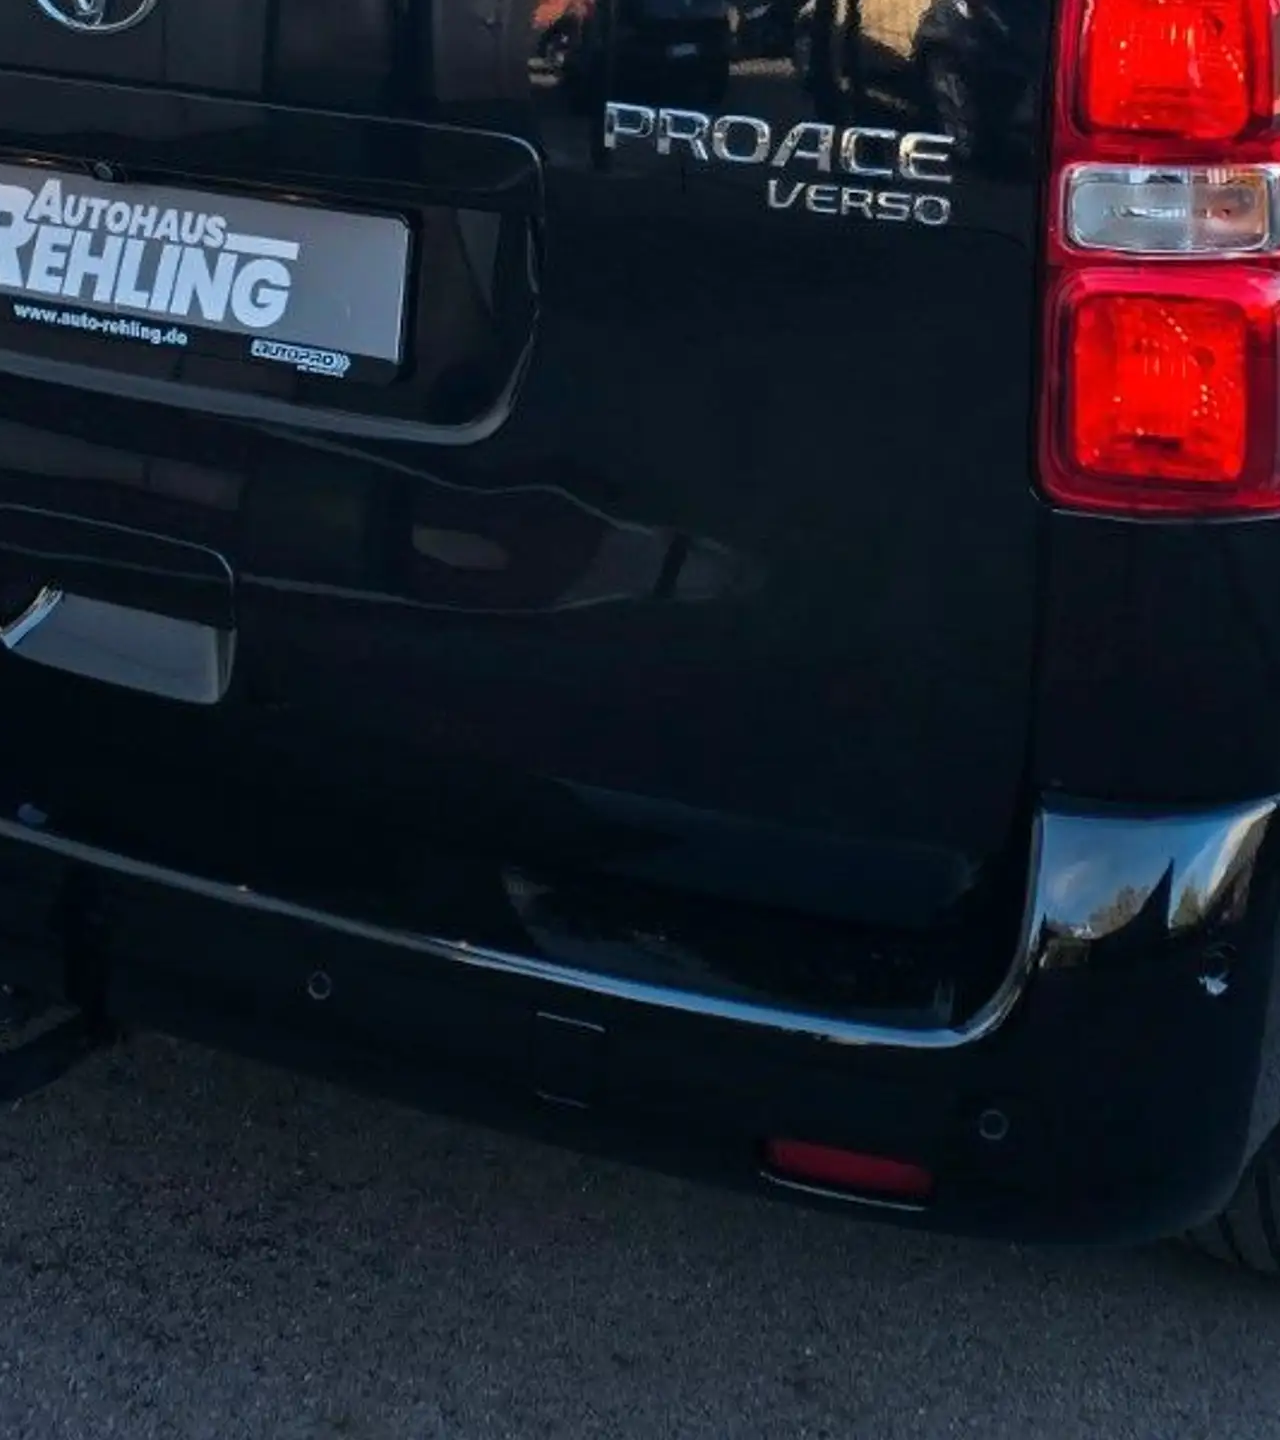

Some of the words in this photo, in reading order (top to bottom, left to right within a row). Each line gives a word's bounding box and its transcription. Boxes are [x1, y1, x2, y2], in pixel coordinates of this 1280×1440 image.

[604, 101, 955, 183] PROACE
[27, 178, 227, 249] AUTOHAUS
[768, 179, 952, 227] VERSO
[13, 303, 188, 347] www.auto-rehling.de
